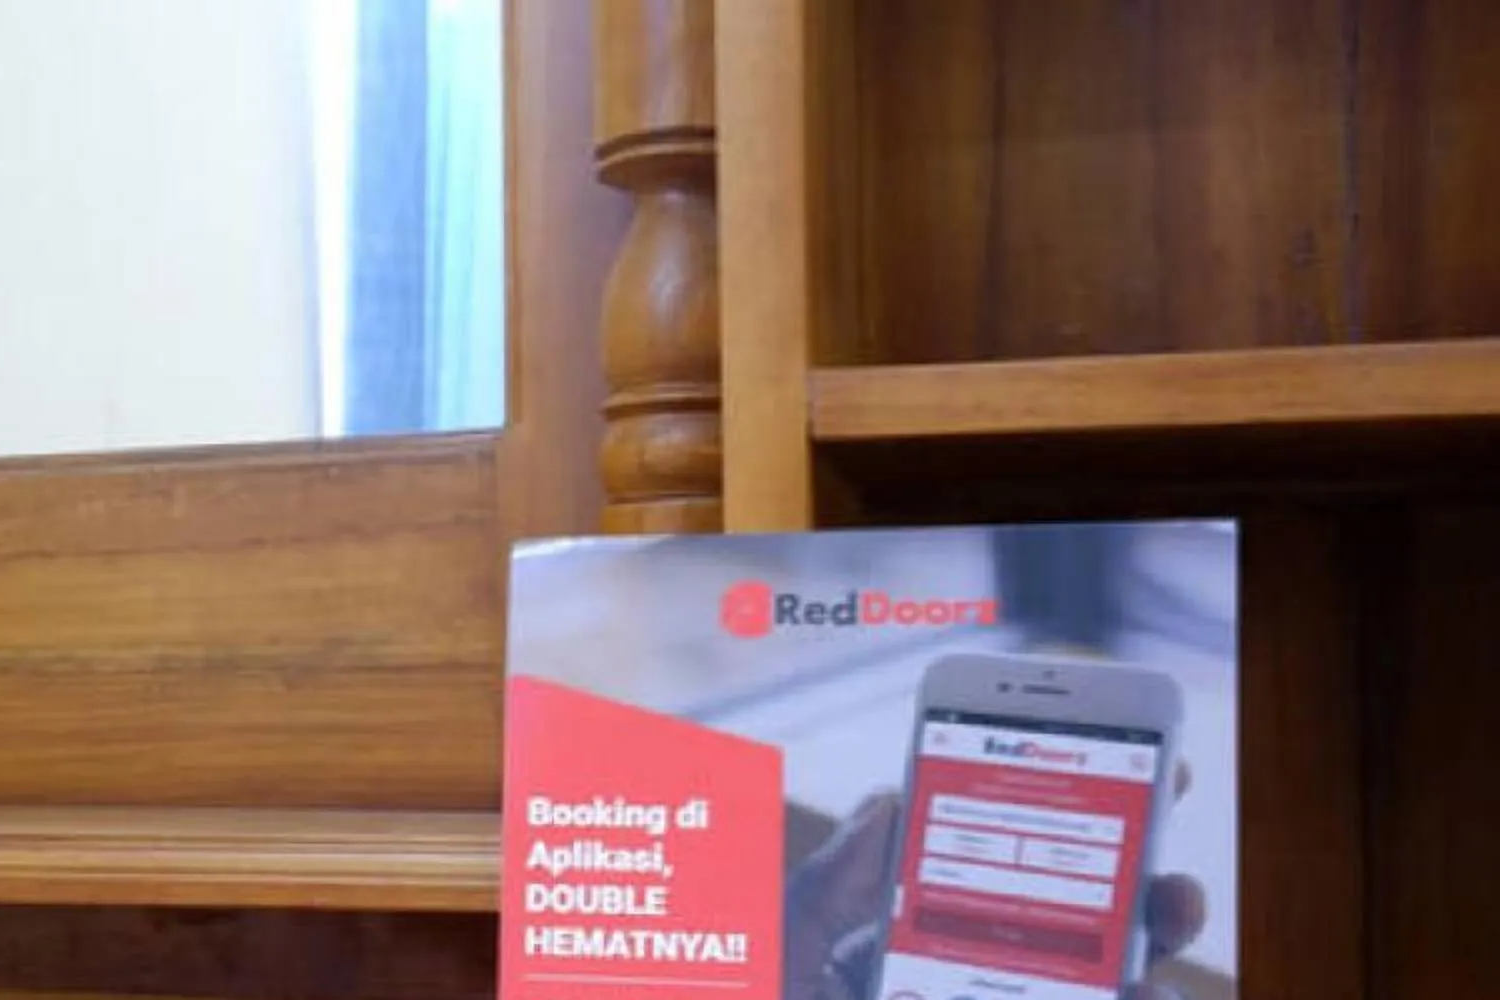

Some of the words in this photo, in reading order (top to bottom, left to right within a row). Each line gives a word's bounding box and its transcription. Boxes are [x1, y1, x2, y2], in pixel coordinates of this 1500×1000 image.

[526, 796, 667, 835] Booking
[675, 797, 710, 829] di
[526, 839, 674, 878] Aplikasi,
[525, 882, 668, 915] DOUBLE
[524, 925, 749, 963] HEMATNYA!!
